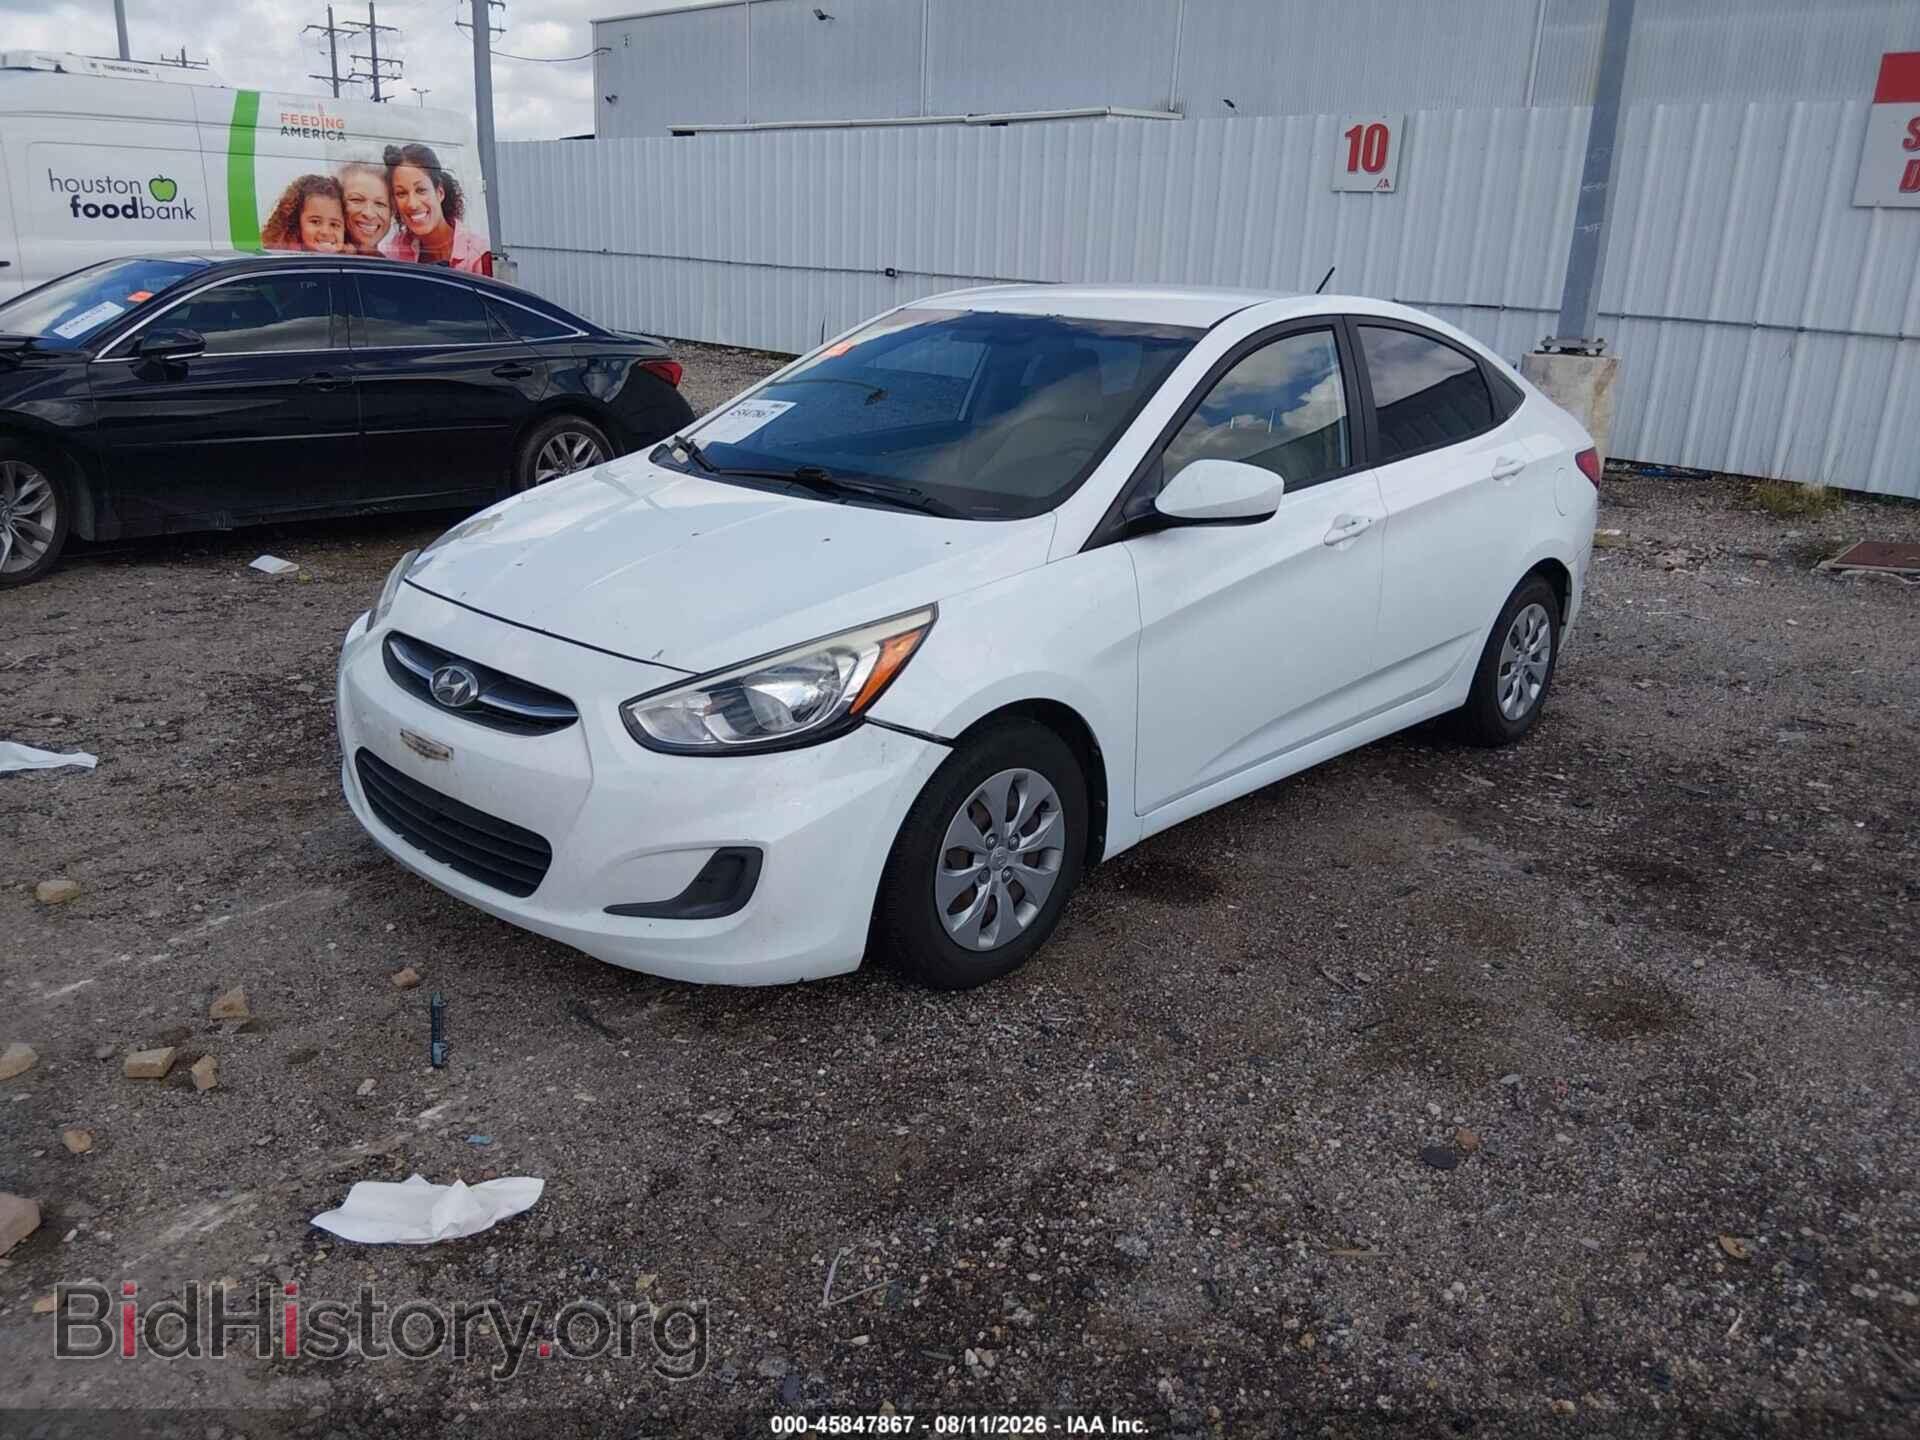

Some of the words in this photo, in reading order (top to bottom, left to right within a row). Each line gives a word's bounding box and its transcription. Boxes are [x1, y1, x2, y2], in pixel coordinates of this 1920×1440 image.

[280, 113, 345, 129] FEEDING
[280, 126, 346, 142] AMERICA
[1344, 123, 1389, 174] 10
[48, 168, 142, 194] houston
[70, 194, 197, 221] foodbank
